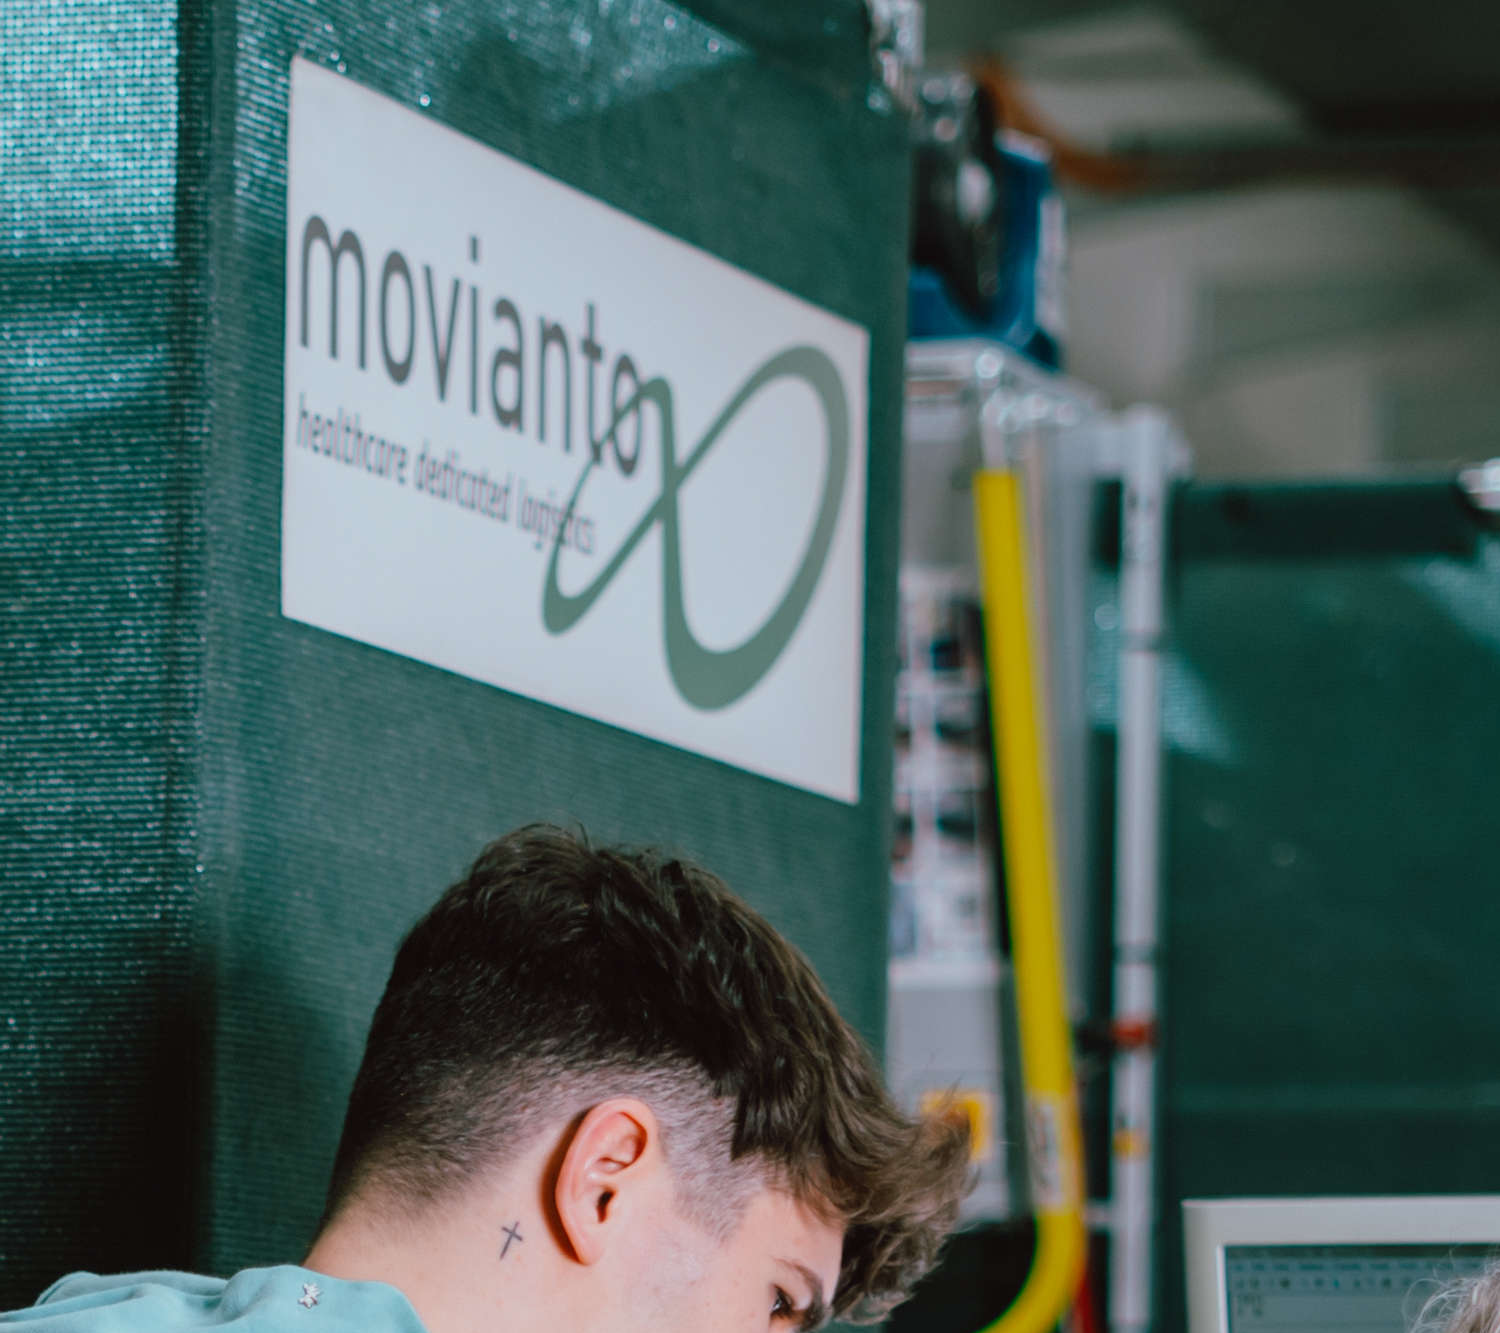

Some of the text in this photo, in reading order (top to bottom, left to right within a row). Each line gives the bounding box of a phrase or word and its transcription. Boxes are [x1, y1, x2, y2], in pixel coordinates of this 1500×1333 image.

[299, 214, 642, 479] movianto
[298, 391, 406, 487] healthcare
[414, 440, 511, 523] dedicated
